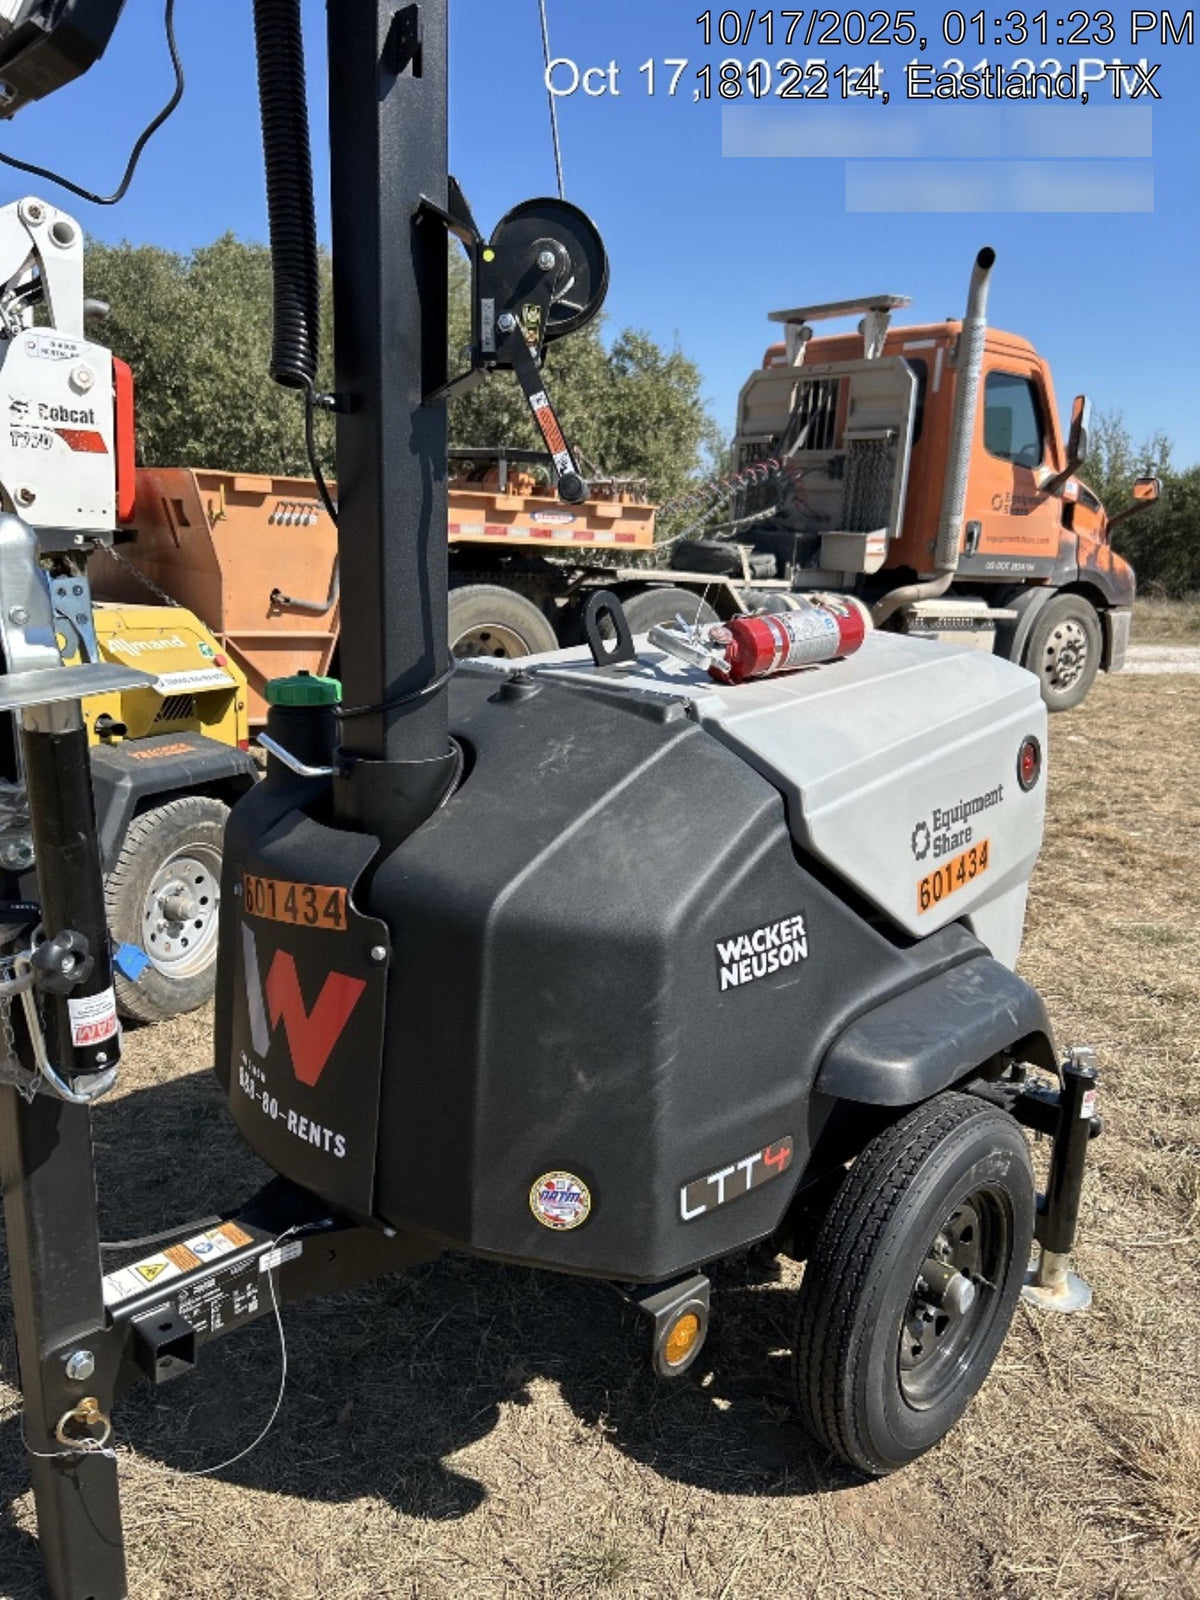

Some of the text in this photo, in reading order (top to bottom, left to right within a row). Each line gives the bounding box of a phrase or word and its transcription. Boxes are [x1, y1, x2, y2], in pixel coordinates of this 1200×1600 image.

[38, 402, 95, 425] Bobcat
[932, 783, 1004, 832] Equipment
[932, 826, 973, 858] Share
[919, 840, 989, 912] 601434
[245, 876, 342, 927] 601434
[716, 915, 806, 965] WACKER
[720, 936, 808, 991] NEUSON
